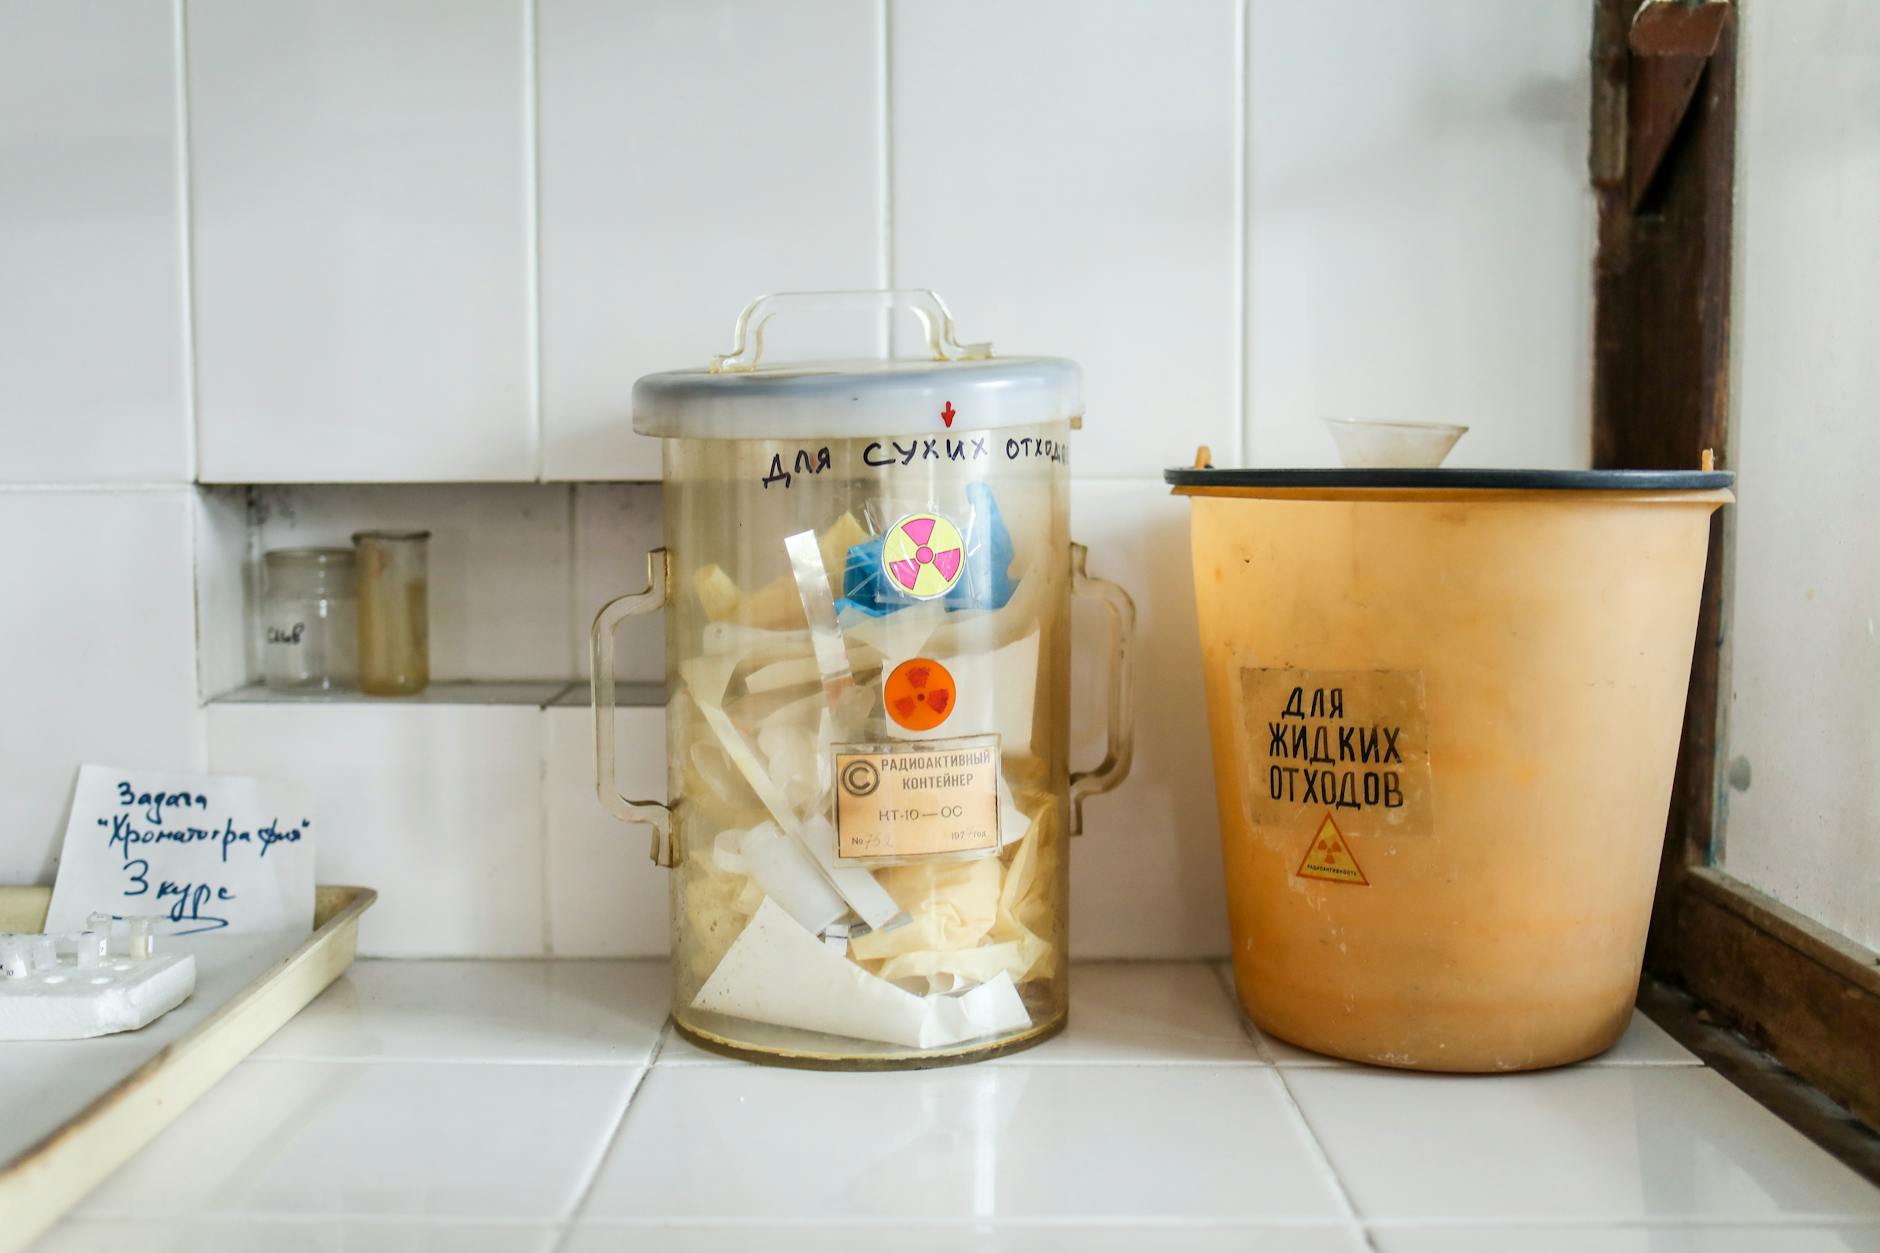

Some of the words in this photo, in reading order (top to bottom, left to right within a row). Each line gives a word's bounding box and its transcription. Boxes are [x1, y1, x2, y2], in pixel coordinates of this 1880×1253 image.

[762, 443, 832, 489] ДЛЯ
[863, 438, 988, 466] СУХИХ
[1005, 438, 1069, 466] ОТХОДО
[1281, 686, 1344, 720] ДЛЯ
[881, 751, 991, 771] РАДИОАКТИВНЫЙ
[1268, 722, 1402, 767] ЖИДКИХ
[902, 772, 974, 791] КОНТЕЙНЕР
[1269, 764, 1404, 811] ОТХОДОВ
